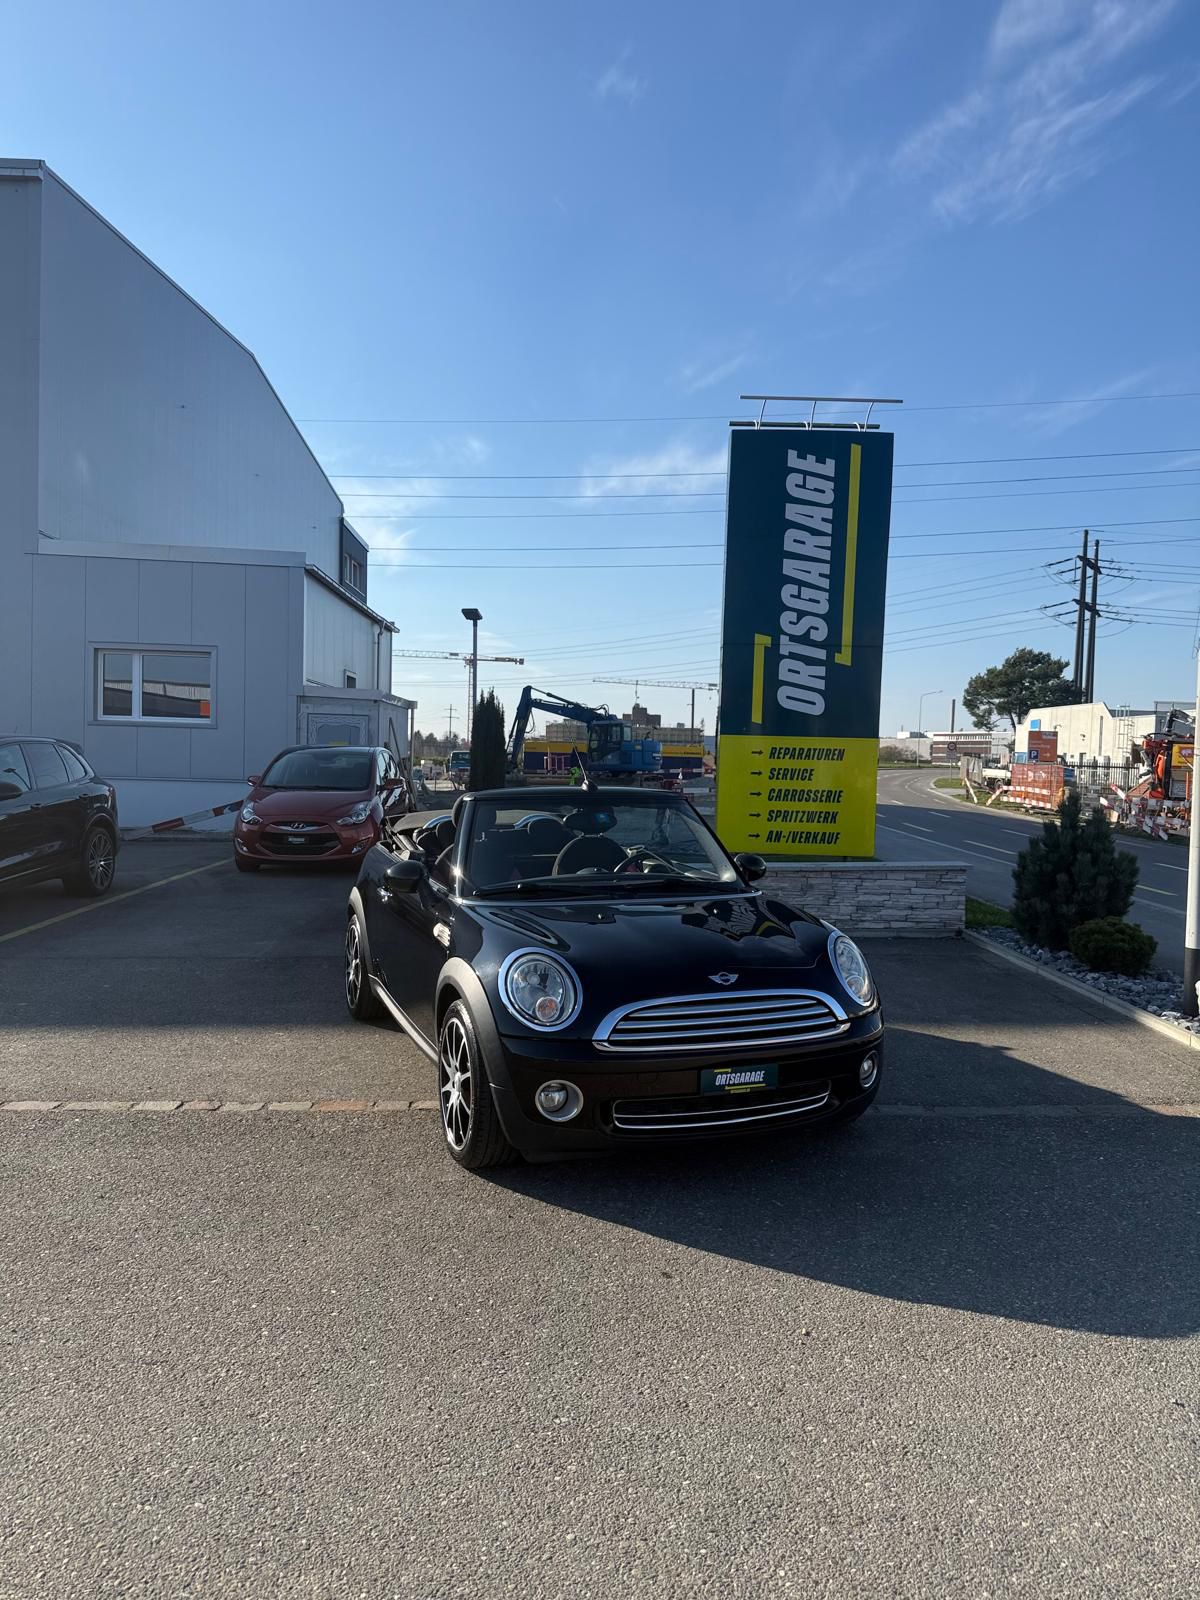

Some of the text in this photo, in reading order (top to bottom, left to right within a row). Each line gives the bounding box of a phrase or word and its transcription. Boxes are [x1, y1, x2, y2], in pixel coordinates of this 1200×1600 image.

[777, 449, 835, 716] ORTSGARAGE
[769, 747, 845, 761] REPARATUREN
[768, 768, 814, 781] SERVICE
[768, 788, 843, 803] CARROSSERIE
[767, 810, 839, 824] SPRITZWERK
[766, 830, 841, 844] AN-/VERKAUF
[715, 1071, 765, 1085] ORTSGARAGE
